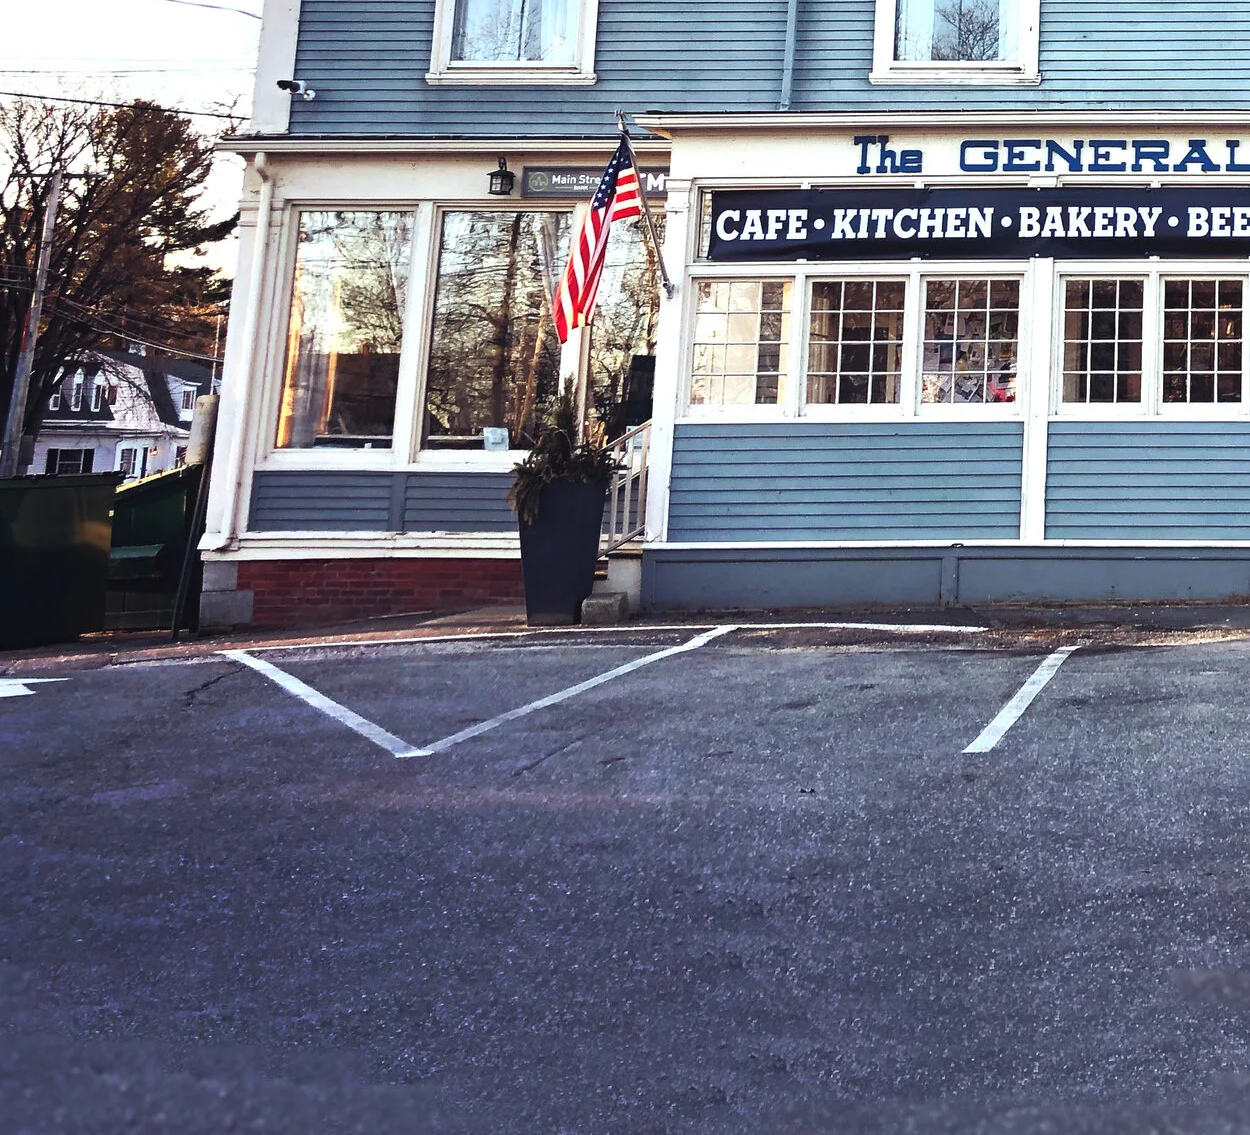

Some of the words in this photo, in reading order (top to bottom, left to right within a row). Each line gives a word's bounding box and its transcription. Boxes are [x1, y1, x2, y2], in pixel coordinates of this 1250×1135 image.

[854, 134, 922, 174] The
[552, 174, 576, 184] Main
[579, 174, 601, 184] Stre
[716, 209, 808, 241] CAFE
[832, 207, 994, 239] KITCHEN
[1018, 206, 1163, 238] BAKERY
